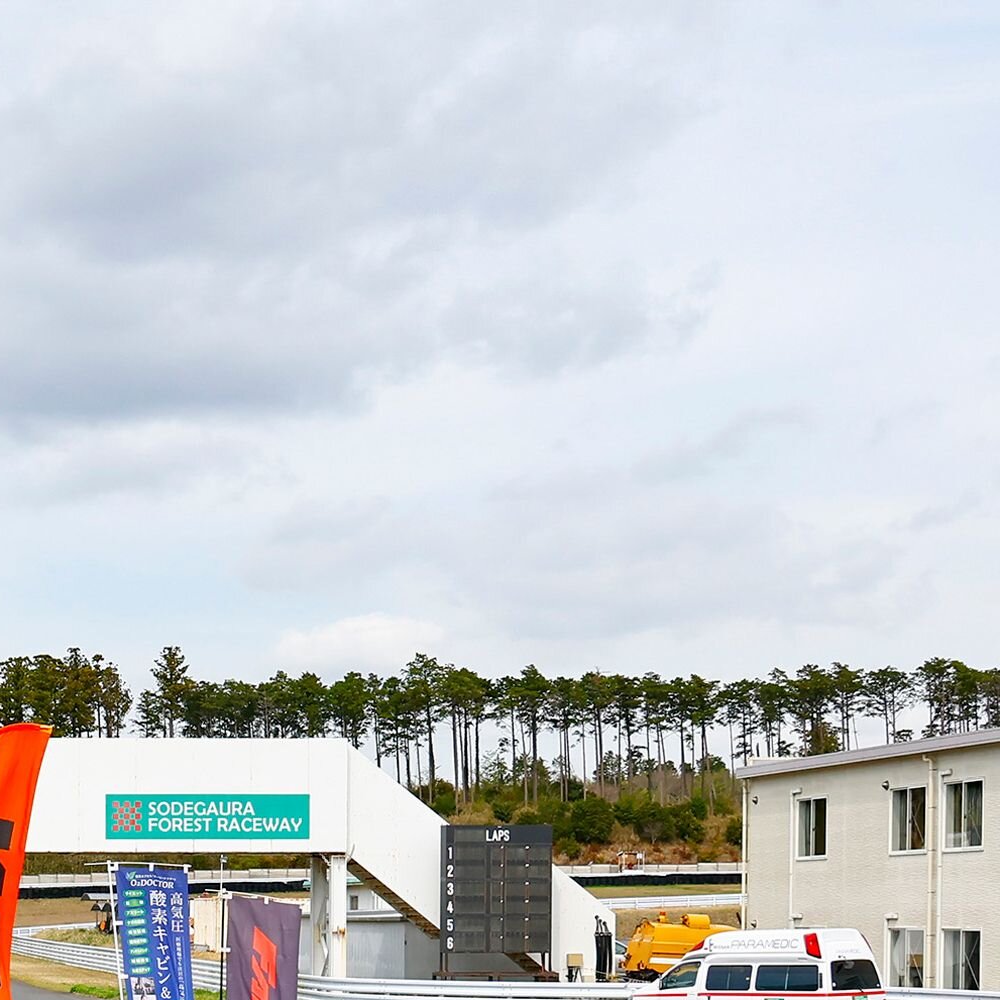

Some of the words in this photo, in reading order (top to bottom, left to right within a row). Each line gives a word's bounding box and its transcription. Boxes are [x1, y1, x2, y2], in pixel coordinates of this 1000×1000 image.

[148, 801, 256, 816] SODEGAURA
[148, 817, 212, 833] FOREST
[216, 817, 303, 833] RACEWAY
[485, 829, 511, 842] LAPS
[447, 846, 453, 860] 1
[446, 865, 454, 878] 2
[446, 882, 454, 896] 3
[170, 892, 185, 933] 高気圧
[446, 900, 454, 914] 4
[446, 918, 454, 932] 5
[446, 936, 454, 950] 6
[731, 938, 800, 949] PARAMEDIC
